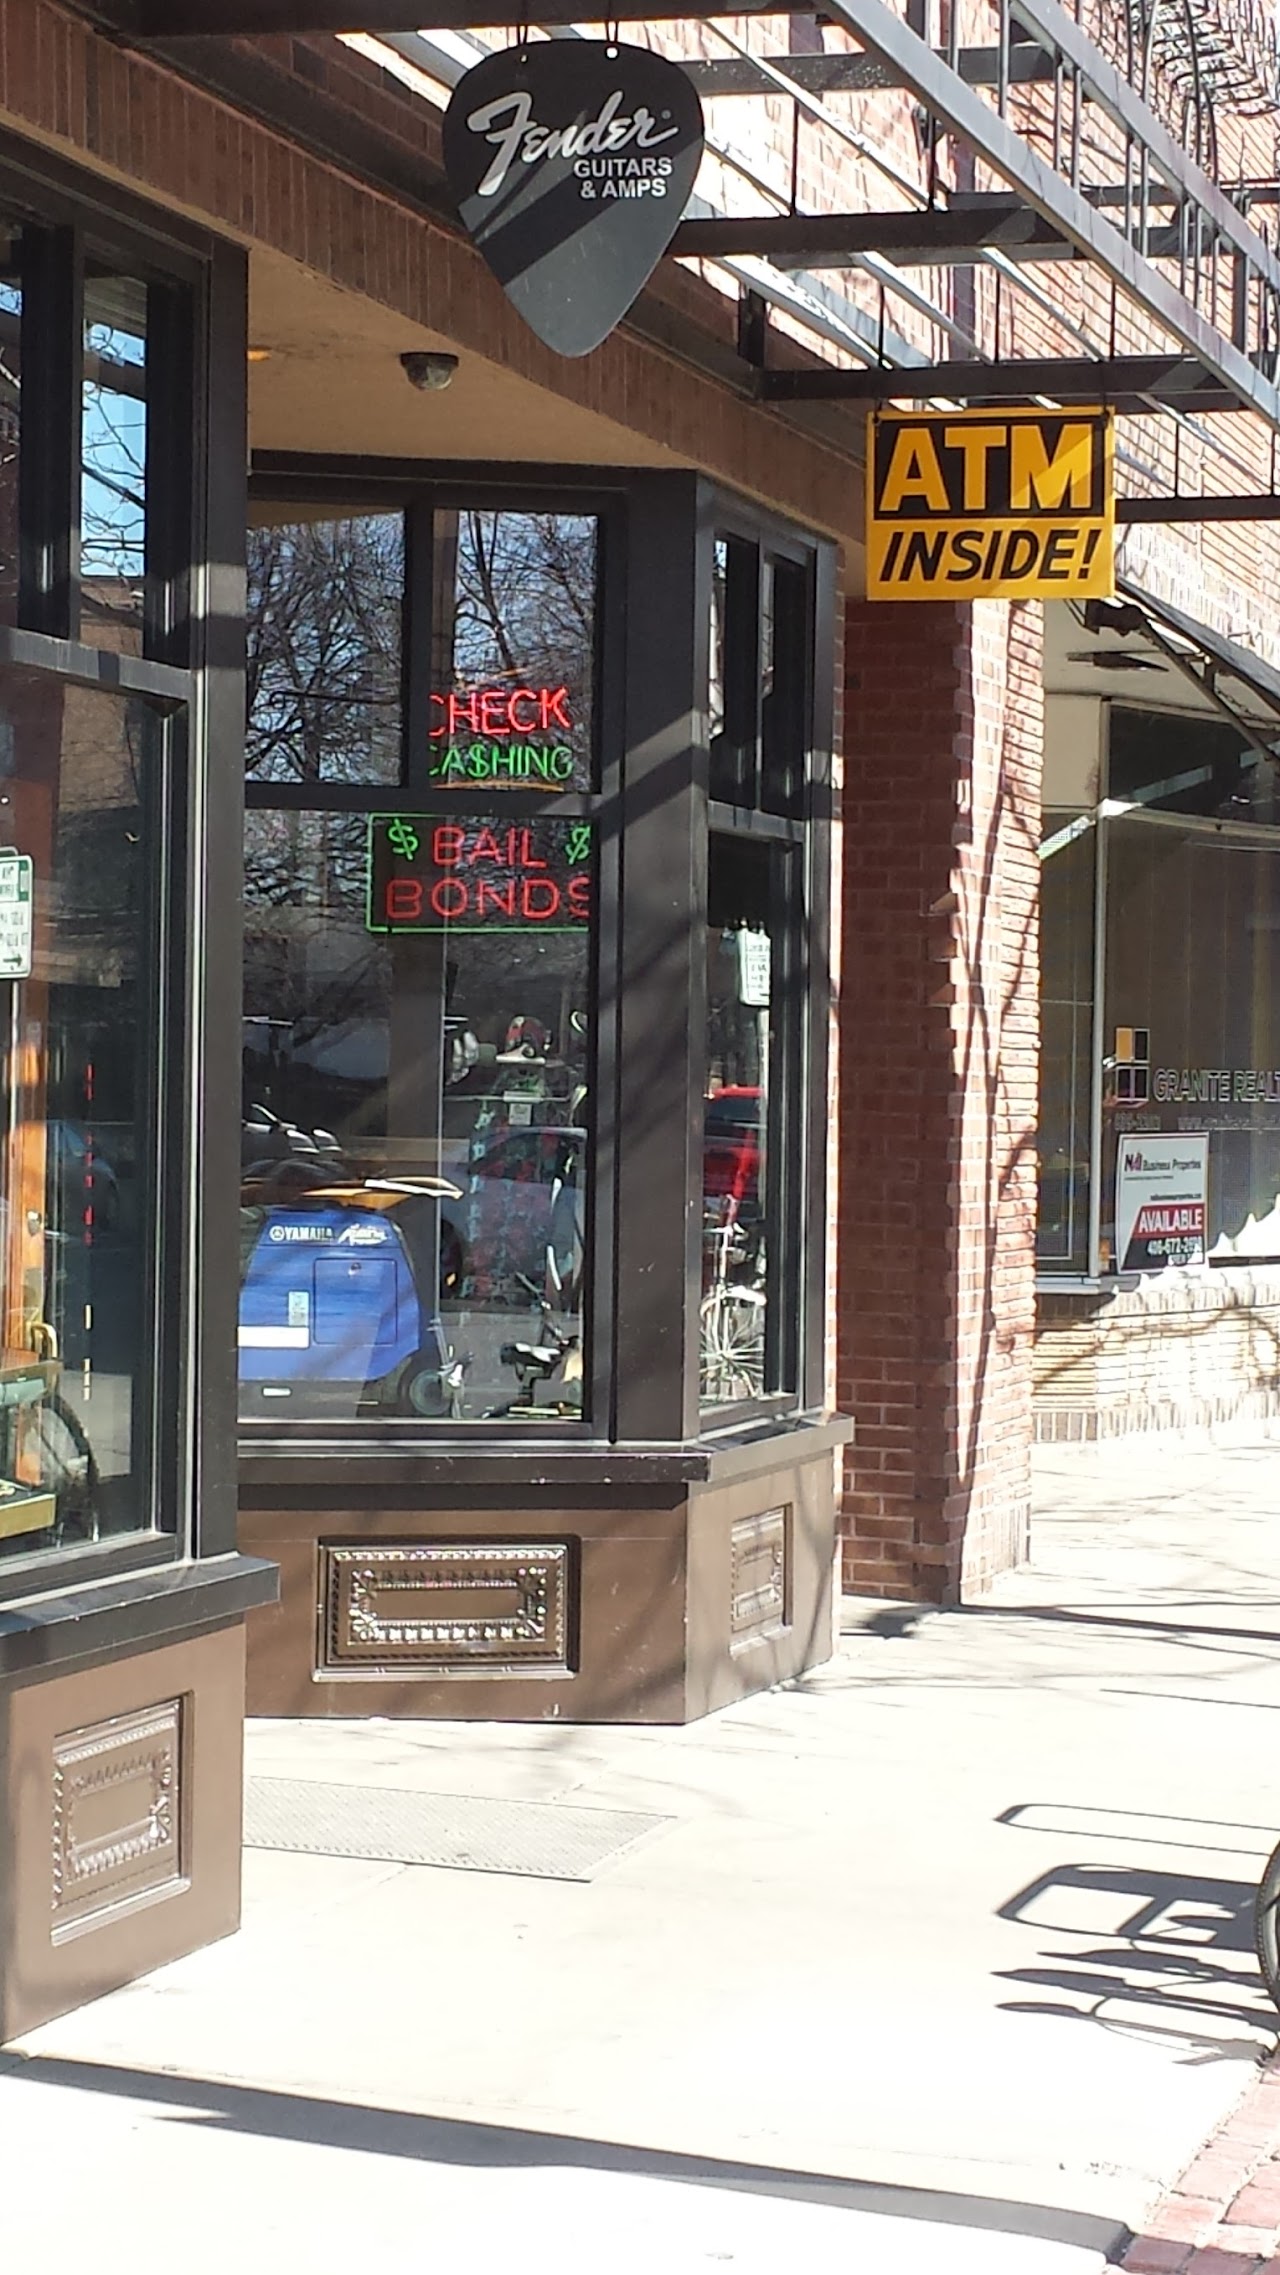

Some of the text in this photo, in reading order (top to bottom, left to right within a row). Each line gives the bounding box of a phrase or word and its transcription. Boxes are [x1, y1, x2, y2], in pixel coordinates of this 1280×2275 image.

[467, 91, 679, 196] Fender
[574, 157, 673, 178] GUITARS
[580, 179, 667, 199] & AMPS
[879, 423, 1093, 511] ATM
[879, 529, 1102, 582] INSIDE!
[432, 825, 547, 868] BAIL
[386, 876, 591, 919] BONDS
[1153, 1069, 1231, 1102] GRANITE
[1138, 1208, 1203, 1234] AVAILABLE
